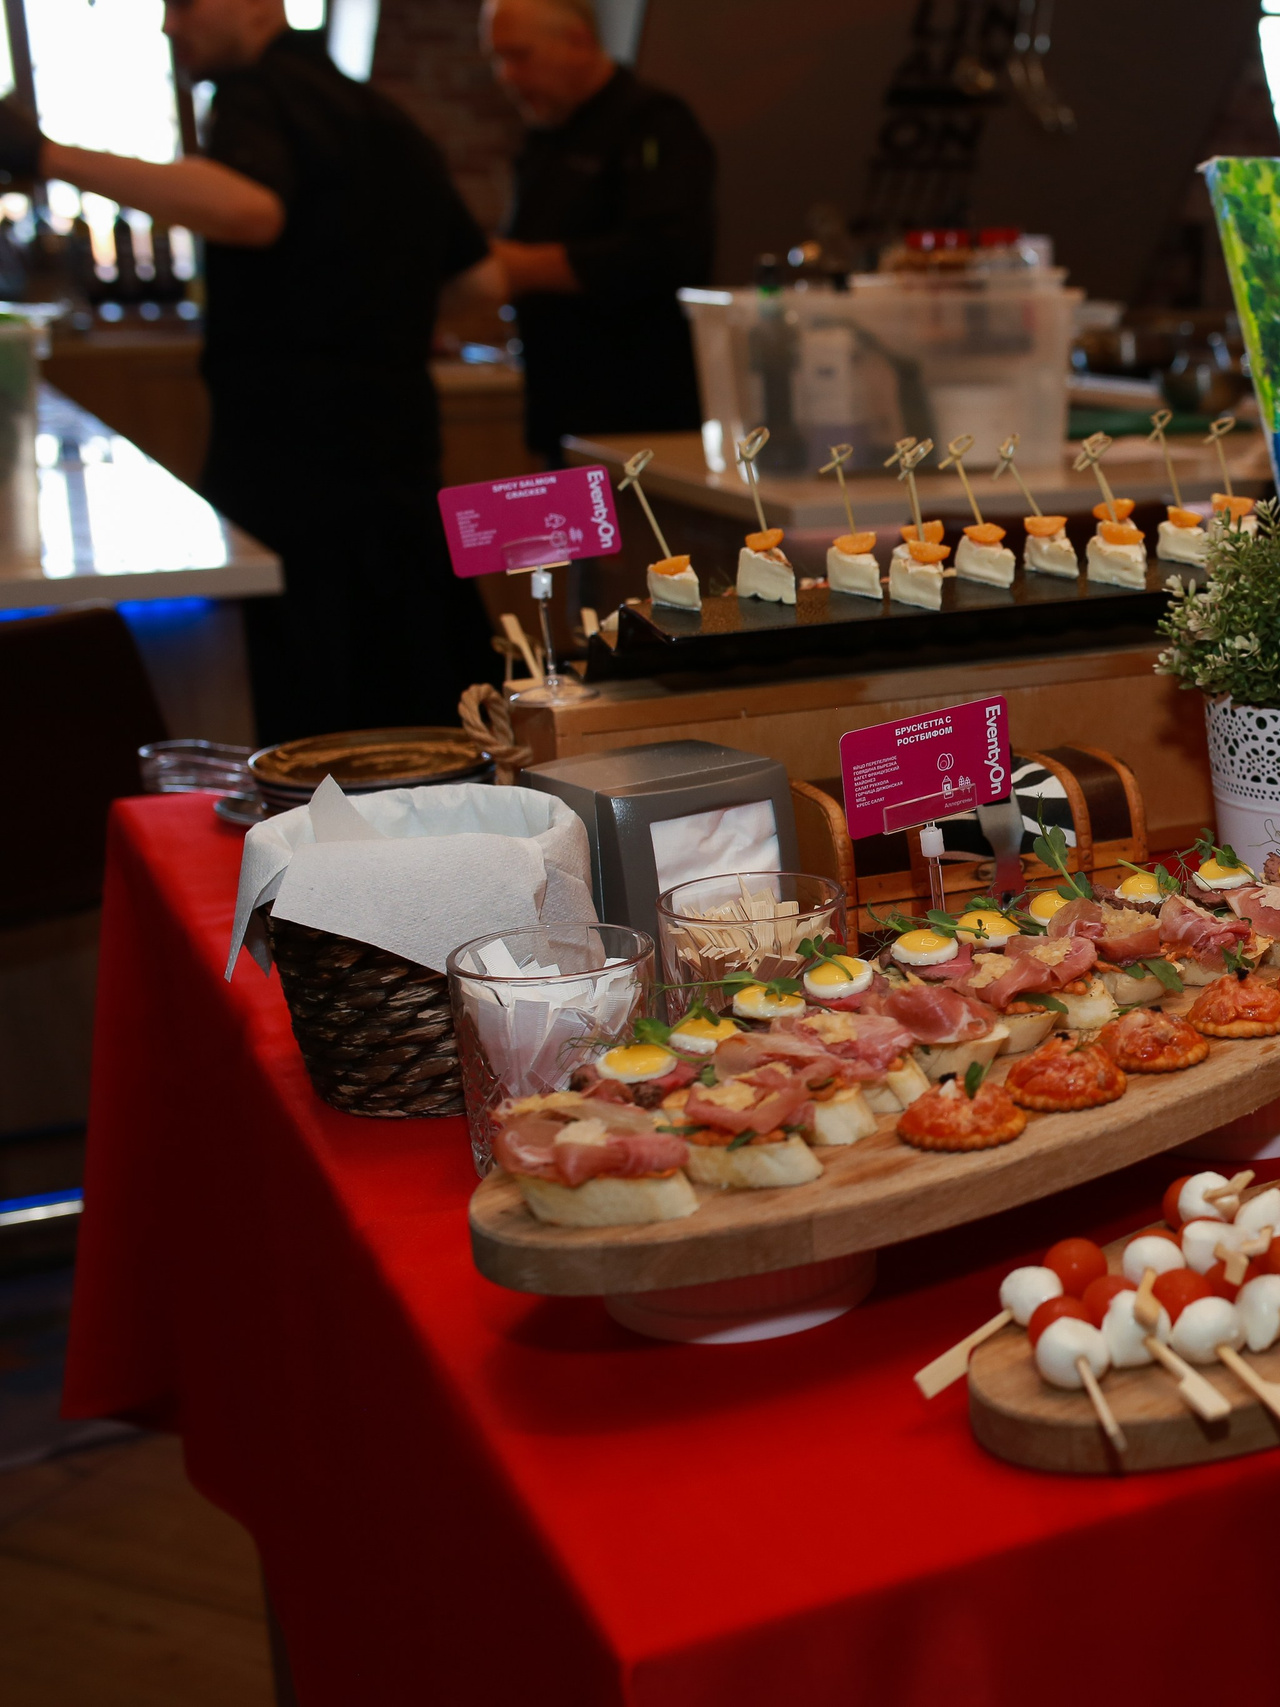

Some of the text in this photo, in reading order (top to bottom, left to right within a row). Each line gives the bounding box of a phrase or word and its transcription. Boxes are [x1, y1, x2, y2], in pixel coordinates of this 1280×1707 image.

[492, 476, 557, 493] SPICY SALMON
[505, 486, 547, 500] CRACKER
[587, 470, 615, 548] EventyOn
[895, 715, 952, 736] БРУСКЕТТА С
[897, 726, 953, 747] РОСТБИФОМ
[984, 704, 1005, 795] EventyOn
[853, 761, 897, 776] ГОВЯДИНА ВЫРЕЗКА
[866, 755, 897, 767] ПЕРЕПЕЛИНОЕ
[868, 765, 900, 777] ФРАНЦУЗСКИЙ
[854, 777, 876, 786] МАЙОНЕЗ
[855, 781, 903, 797] ГОРЧИЦА ДИЖОНСКАЯ
[871, 796, 885, 804] САЛАТ
[944, 797, 973, 809] Аллергены
